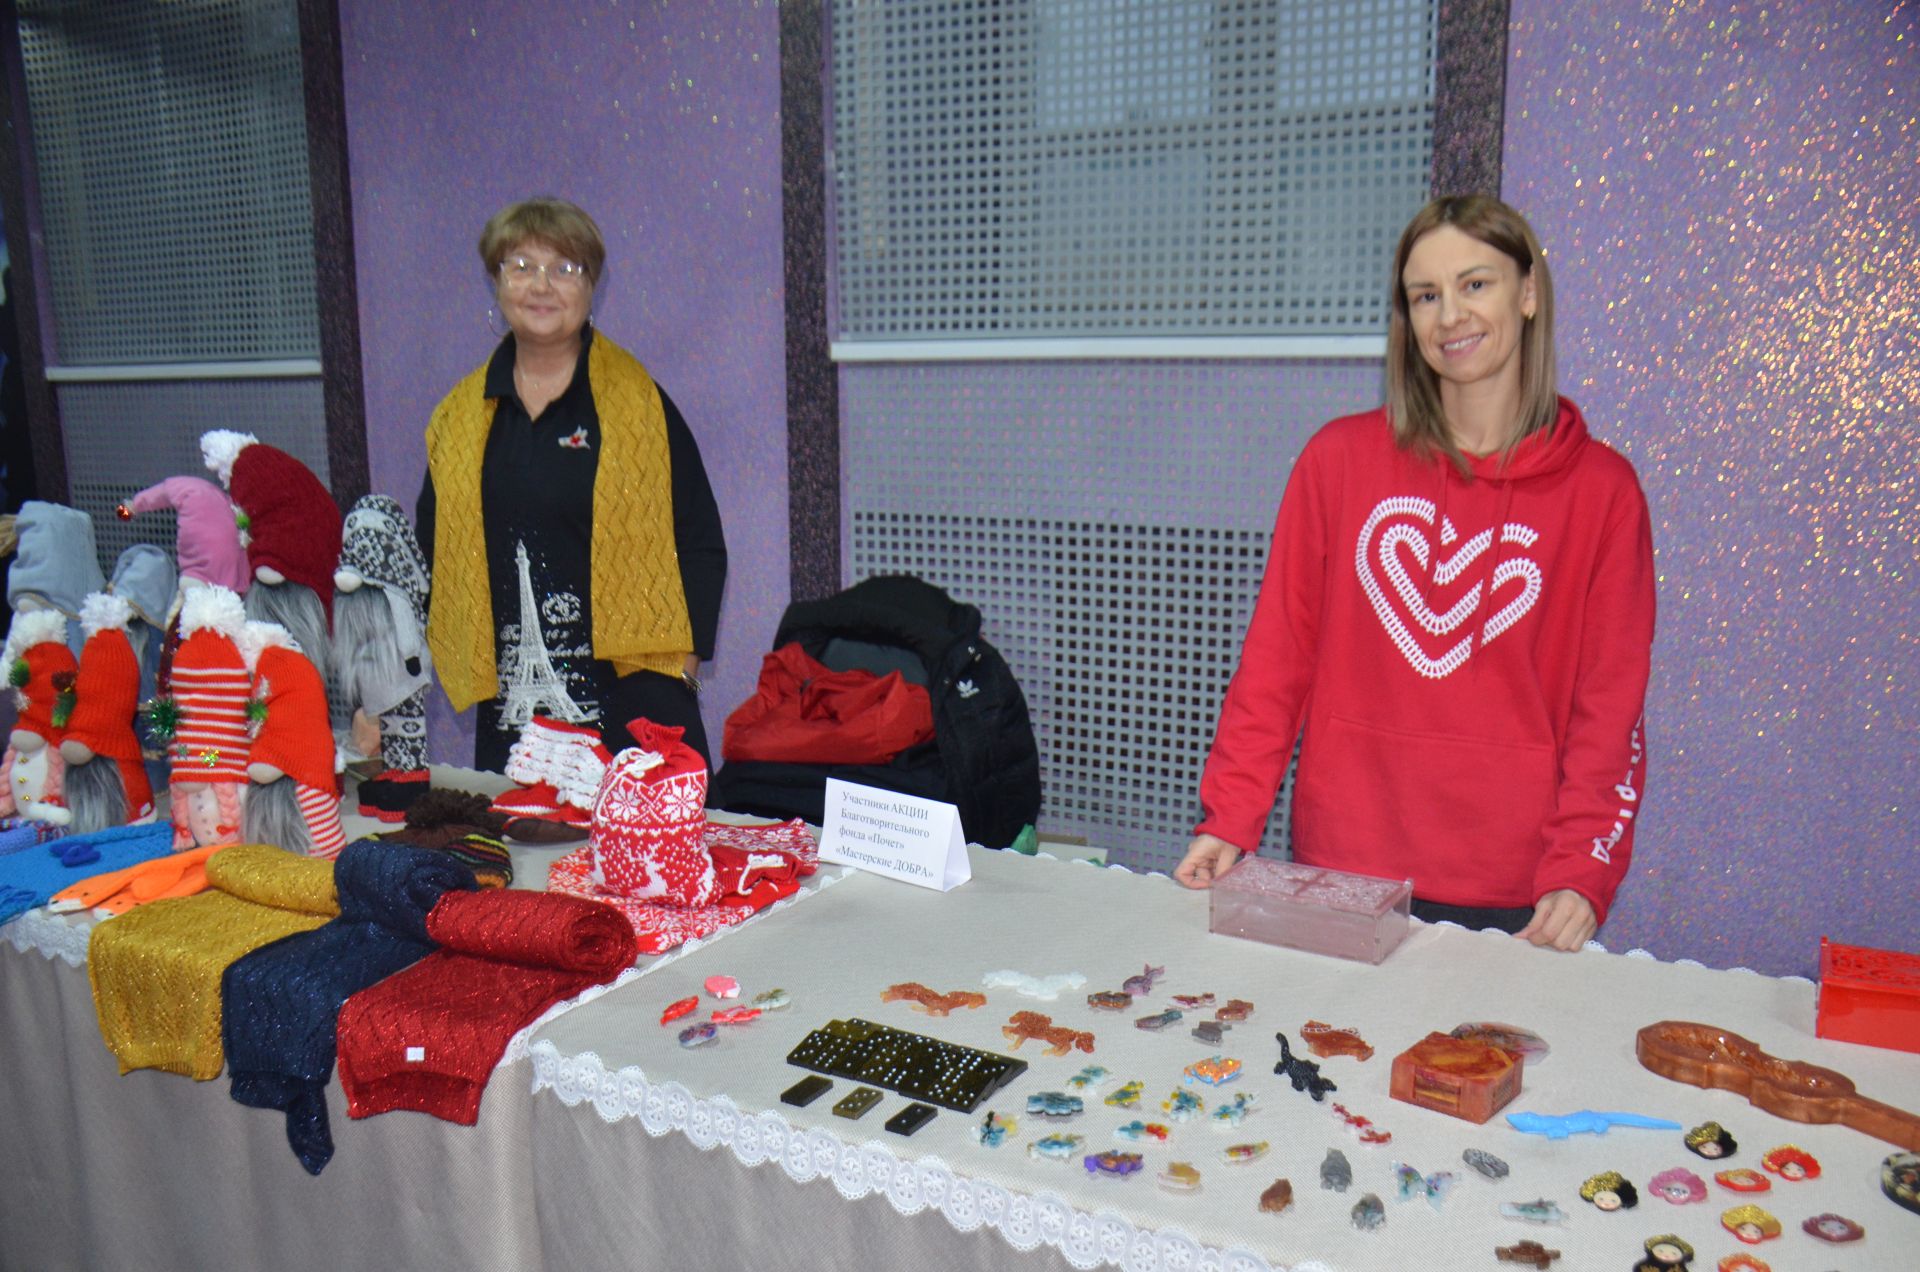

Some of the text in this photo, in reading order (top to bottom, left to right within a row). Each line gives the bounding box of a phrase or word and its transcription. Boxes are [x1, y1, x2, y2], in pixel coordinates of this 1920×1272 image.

[842, 791, 929, 820] Участники АКЦИИ
[839, 825, 866, 840] фонда
[841, 808, 930, 838] Благотворительного
[836, 845, 934, 878] «Мастерские ДОБРА»
